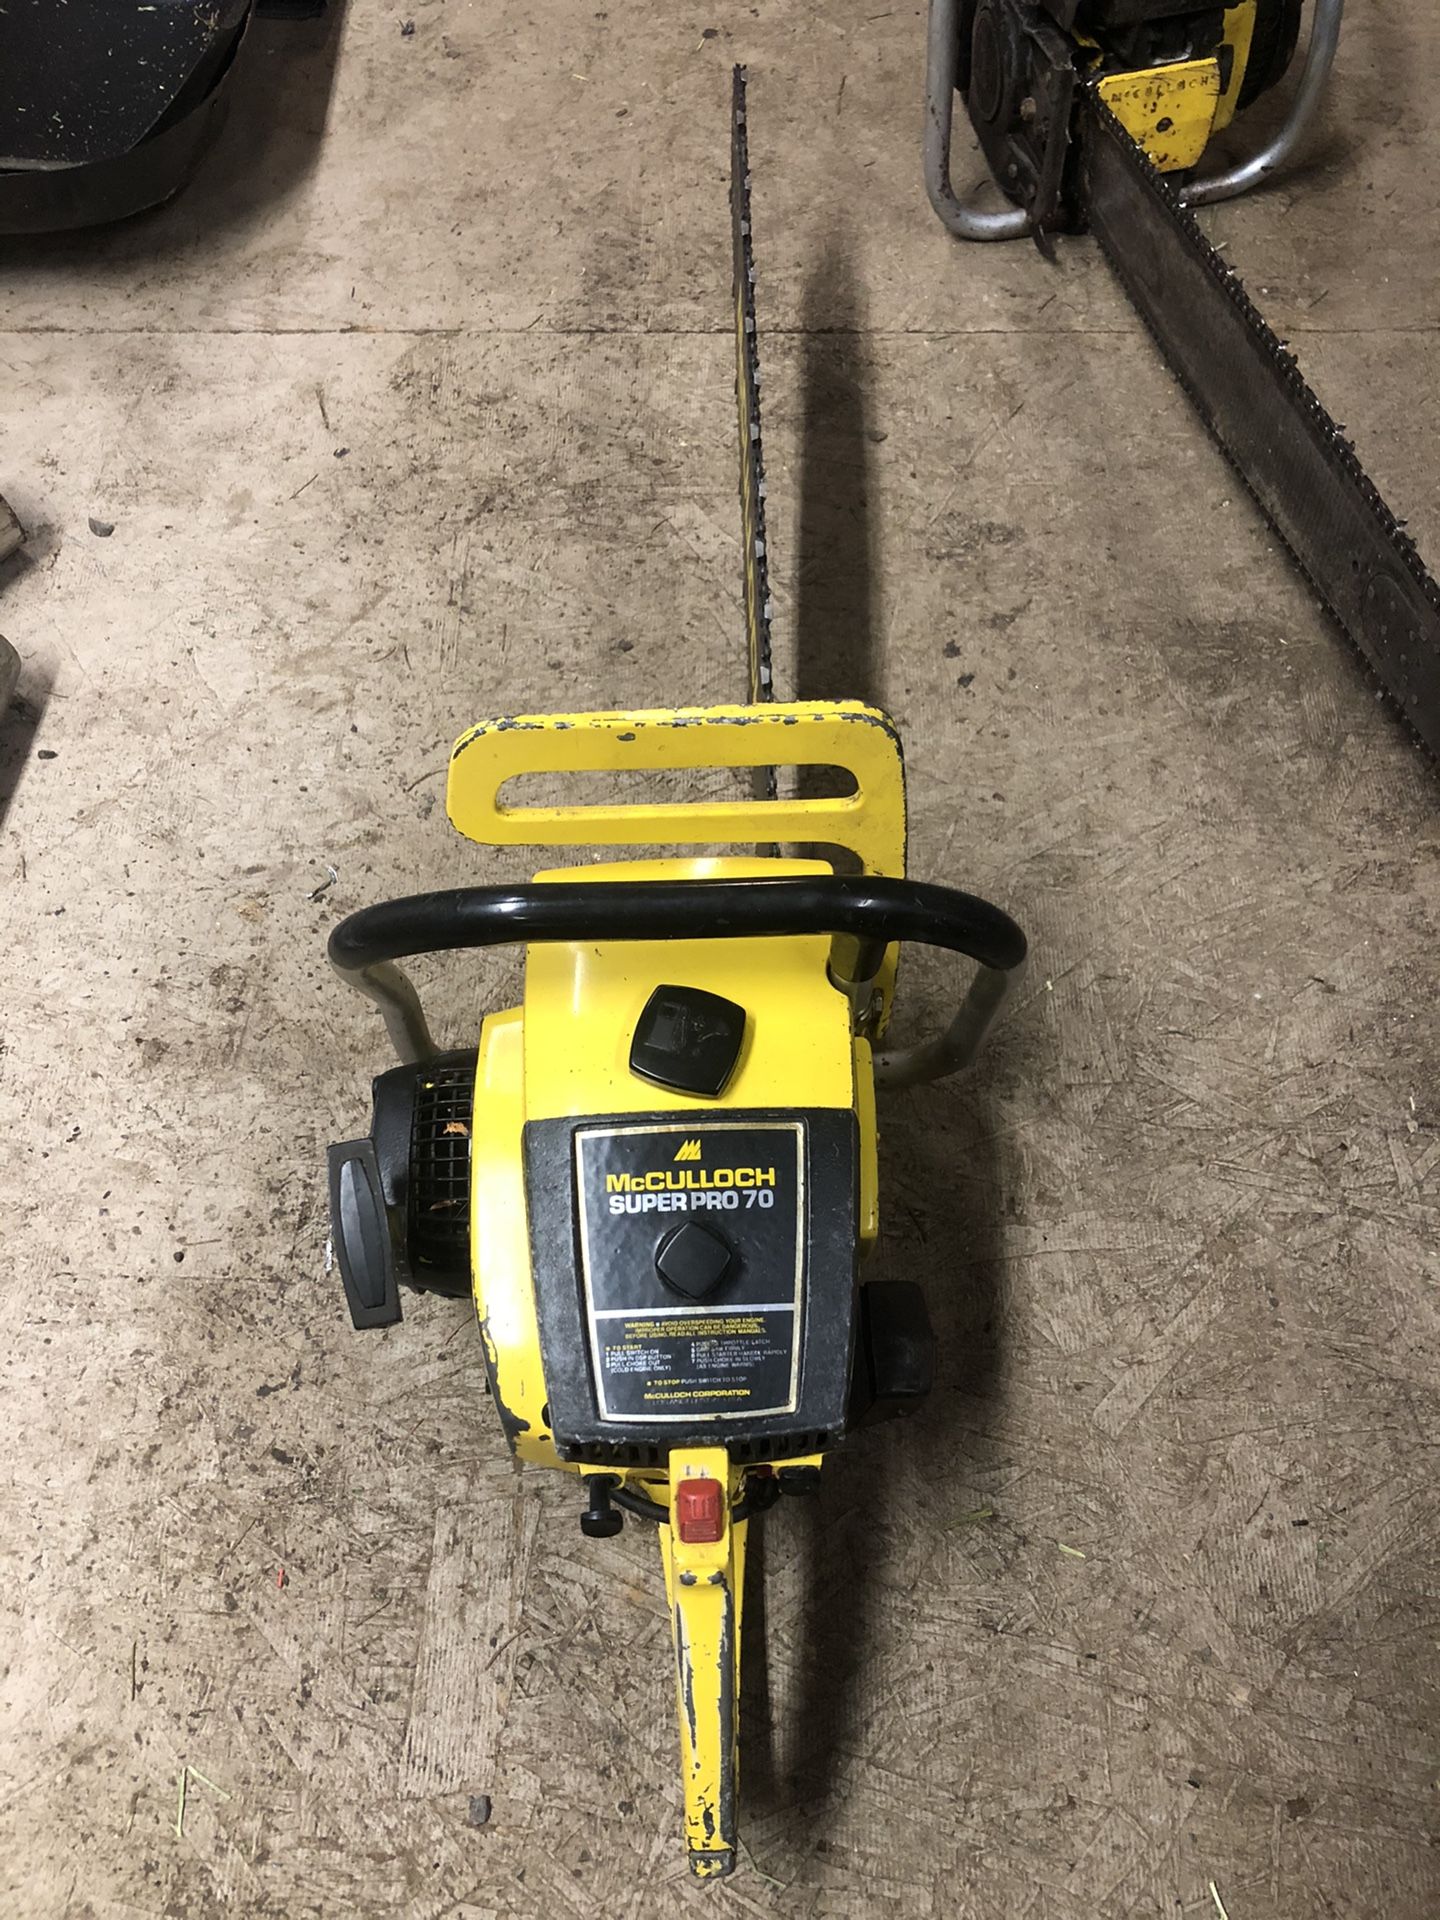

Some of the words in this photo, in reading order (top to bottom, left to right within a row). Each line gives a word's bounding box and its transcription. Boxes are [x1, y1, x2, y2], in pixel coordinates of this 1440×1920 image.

[606, 1167, 776, 1193] McCULLOCH
[609, 1193, 687, 1215] SUPER
[691, 1190, 739, 1210] PRO
[742, 1189, 774, 1209] 70
[644, 1391, 691, 1399] McCULLOCH
[692, 1389, 751, 1398] CORPORATION
